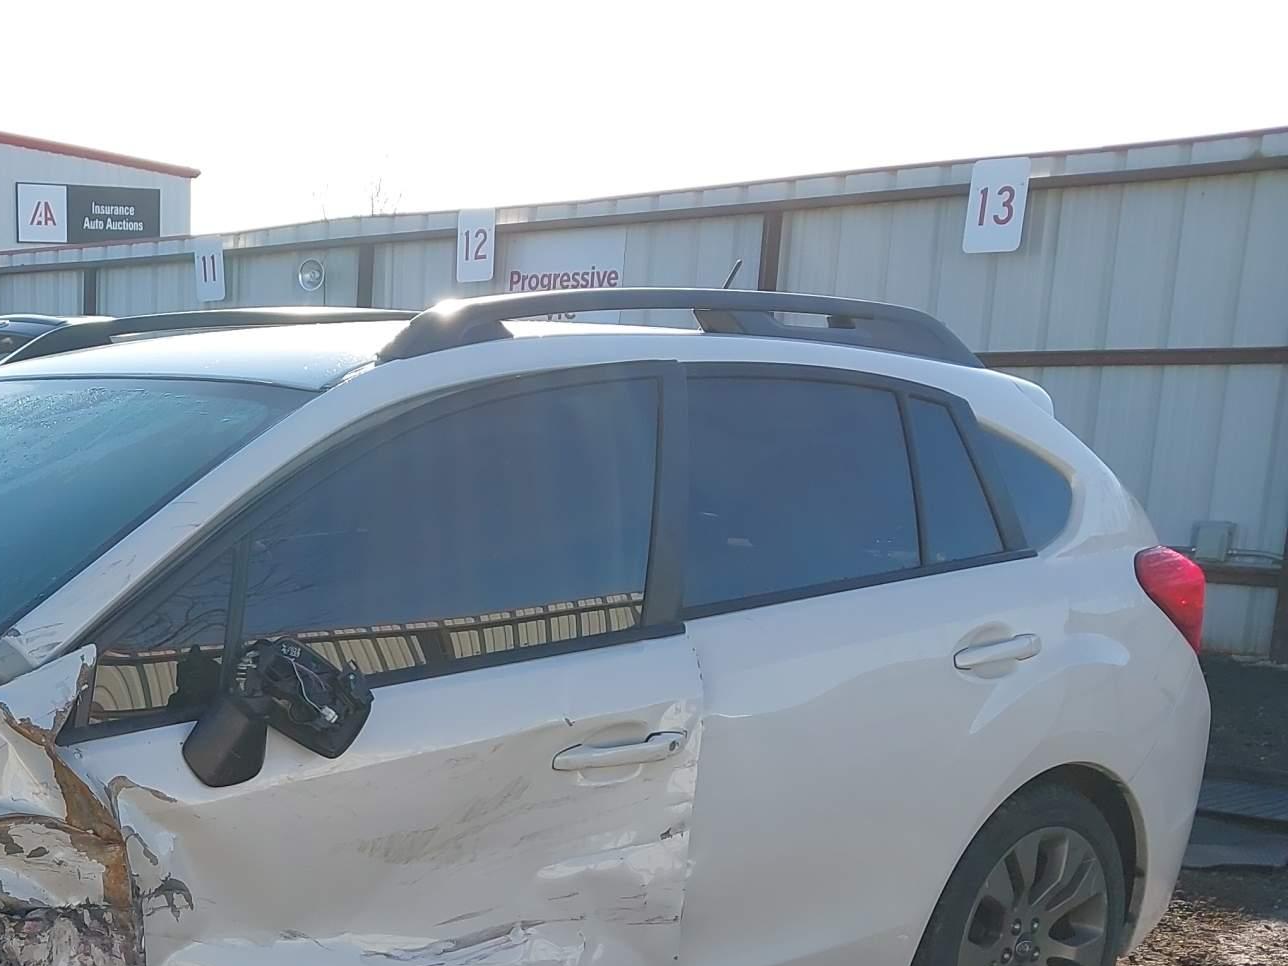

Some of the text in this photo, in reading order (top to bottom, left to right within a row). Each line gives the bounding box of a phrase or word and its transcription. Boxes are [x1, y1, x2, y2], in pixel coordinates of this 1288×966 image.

[91, 201, 135, 216] Insurance
[977, 185, 1016, 226] 13
[82, 217, 144, 231] Auto Auctions
[464, 228, 488, 261] 12
[201, 254, 217, 283] 11
[509, 265, 619, 291] Progressive
